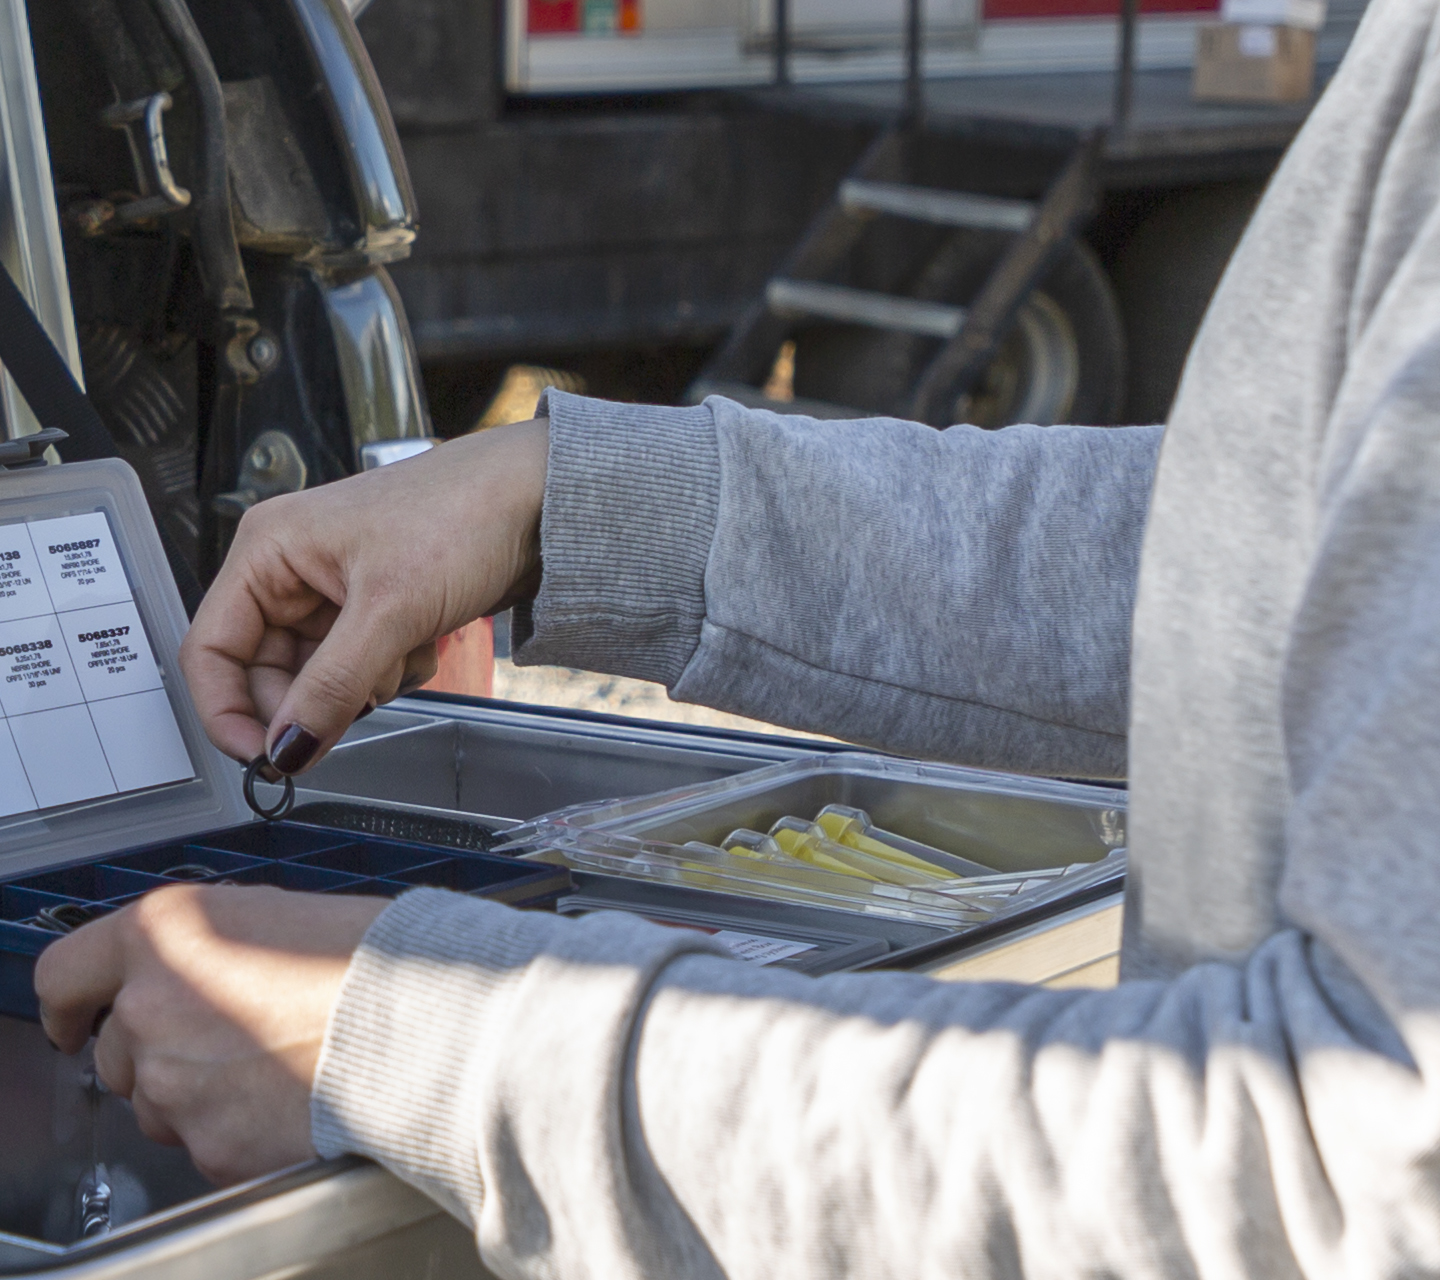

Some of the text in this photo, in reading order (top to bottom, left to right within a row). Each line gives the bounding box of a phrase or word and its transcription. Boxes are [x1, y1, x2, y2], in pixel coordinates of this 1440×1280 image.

[48, 539, 100, 554] 5065887
[78, 626, 130, 643] 5068337
[36, 680, 47, 688] pcs
